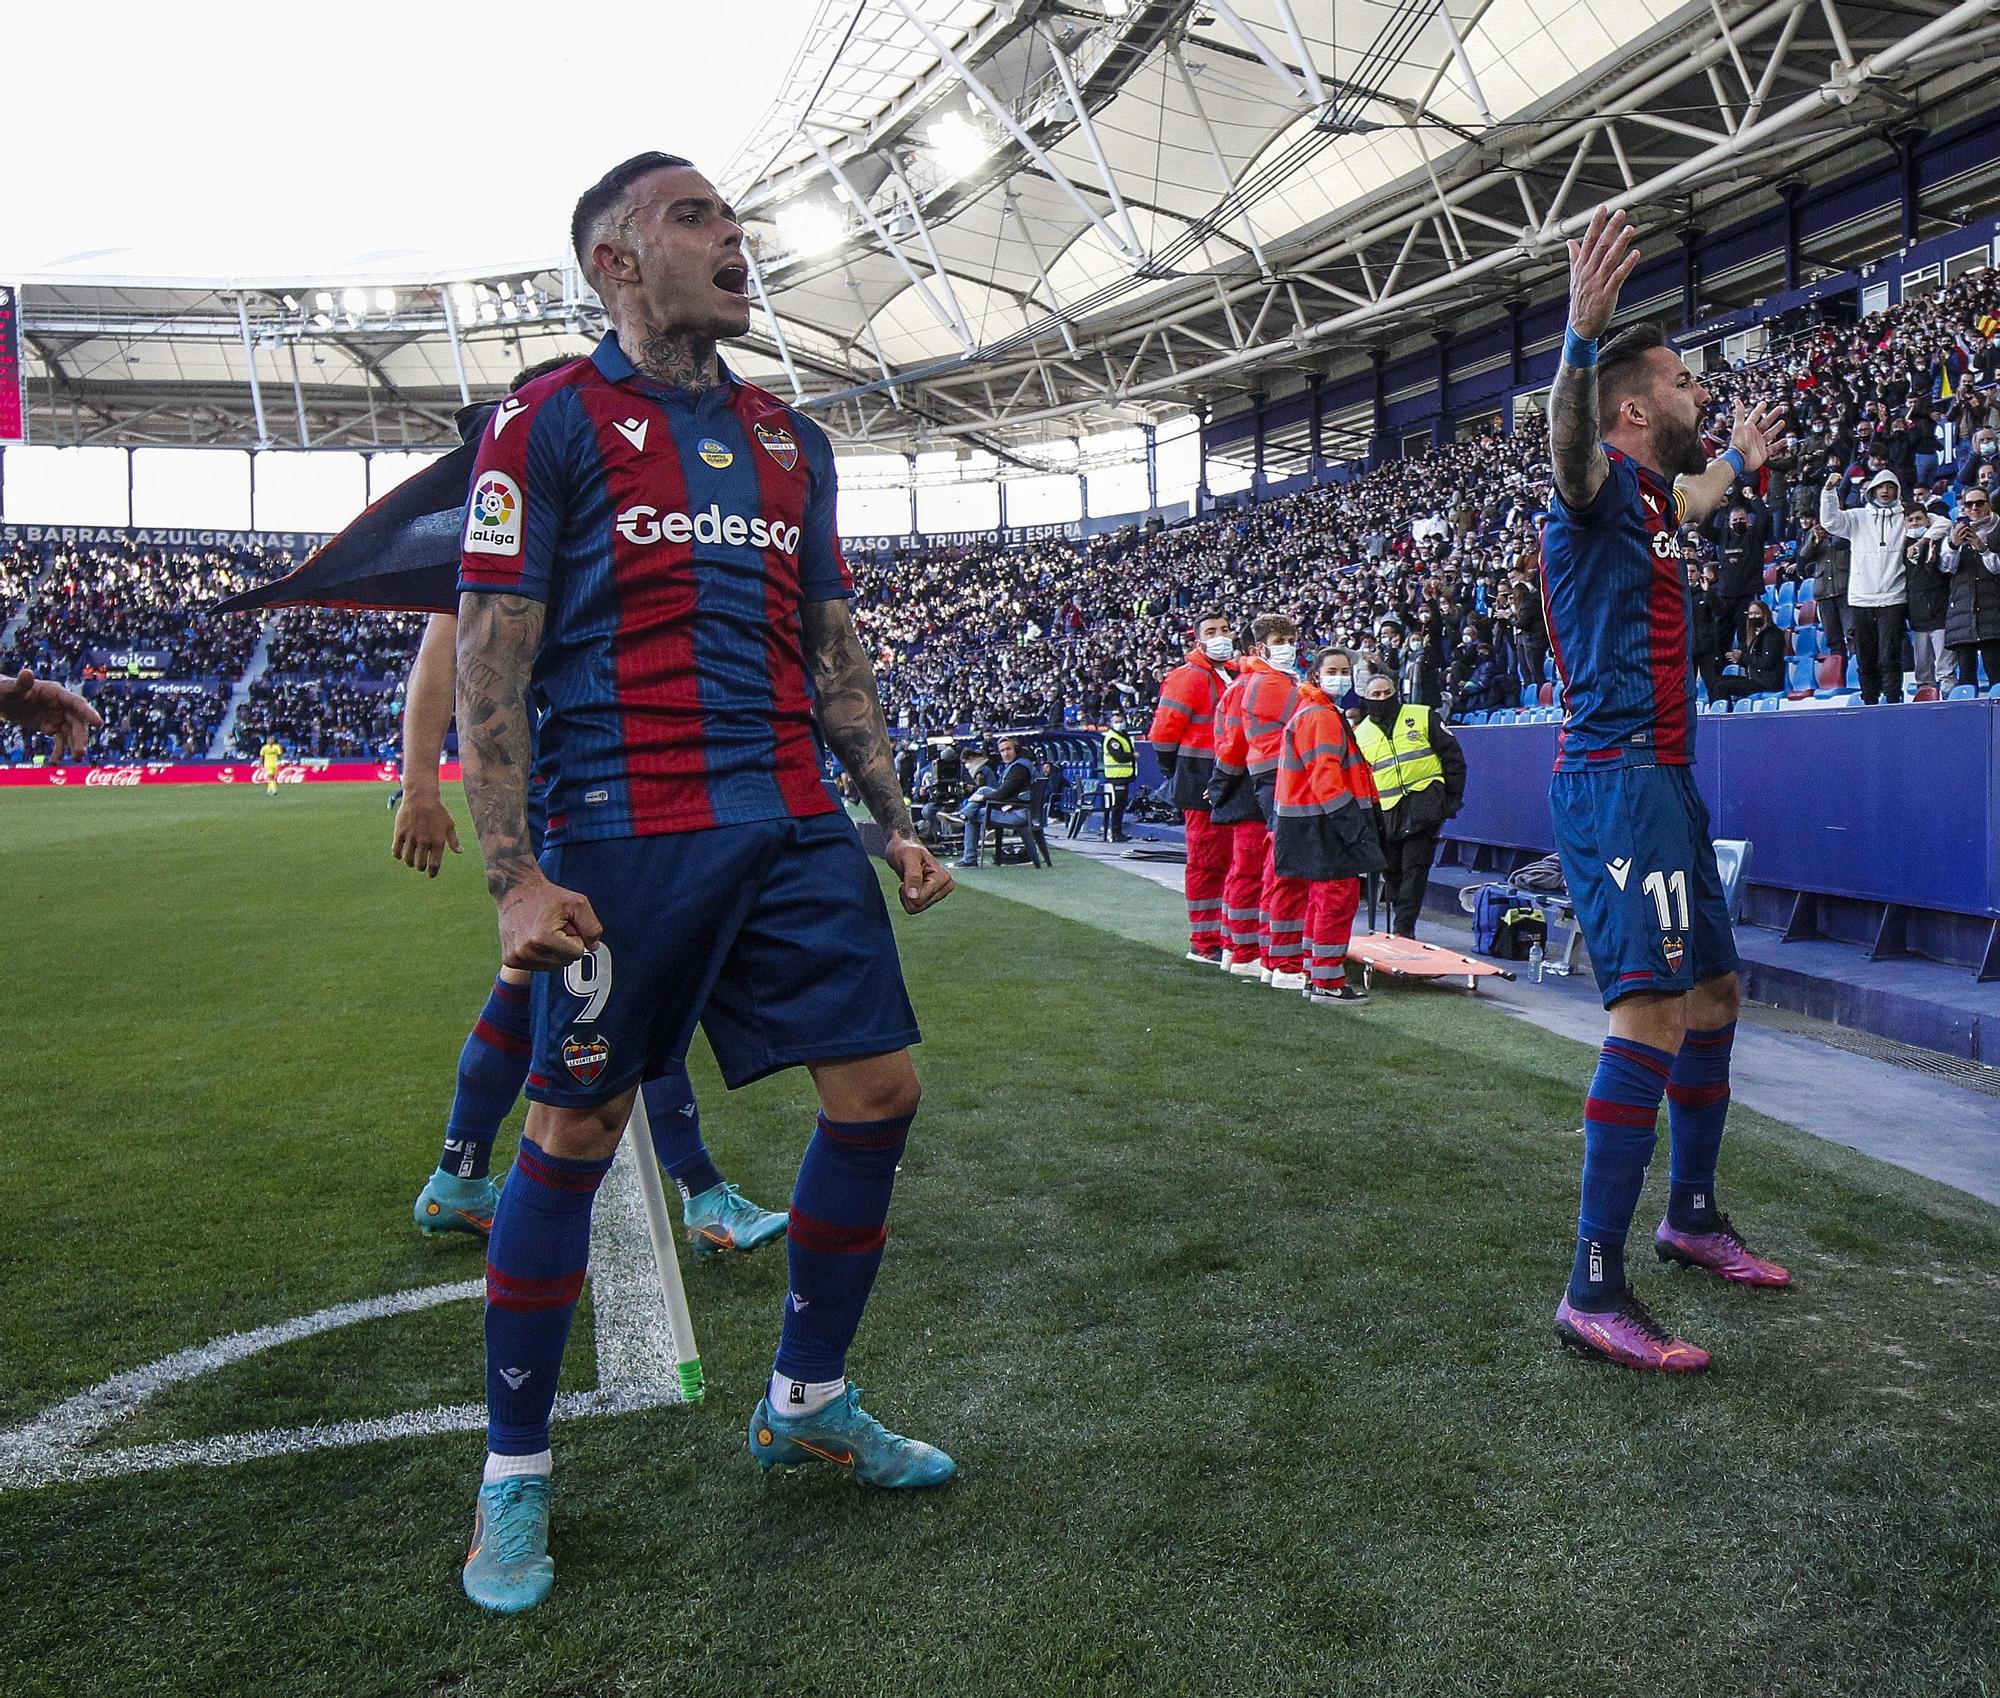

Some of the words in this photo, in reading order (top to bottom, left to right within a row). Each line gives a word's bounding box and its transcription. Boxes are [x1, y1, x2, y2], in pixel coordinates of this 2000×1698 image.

[27, 527, 125, 543] BARRAS
[135, 529, 294, 548] AZULGRANAS
[616, 504, 800, 554] Gedesco
[841, 537, 890, 551] PASO
[900, 535, 920, 550] EL
[925, 531, 998, 549] TRIUNFO
[1002, 528, 1021, 543] TE
[1026, 522, 1082, 542] ESPERA
[109, 653, 156, 667] teika
[1642, 870, 1690, 931] 11
[563, 940, 613, 1023] 9
